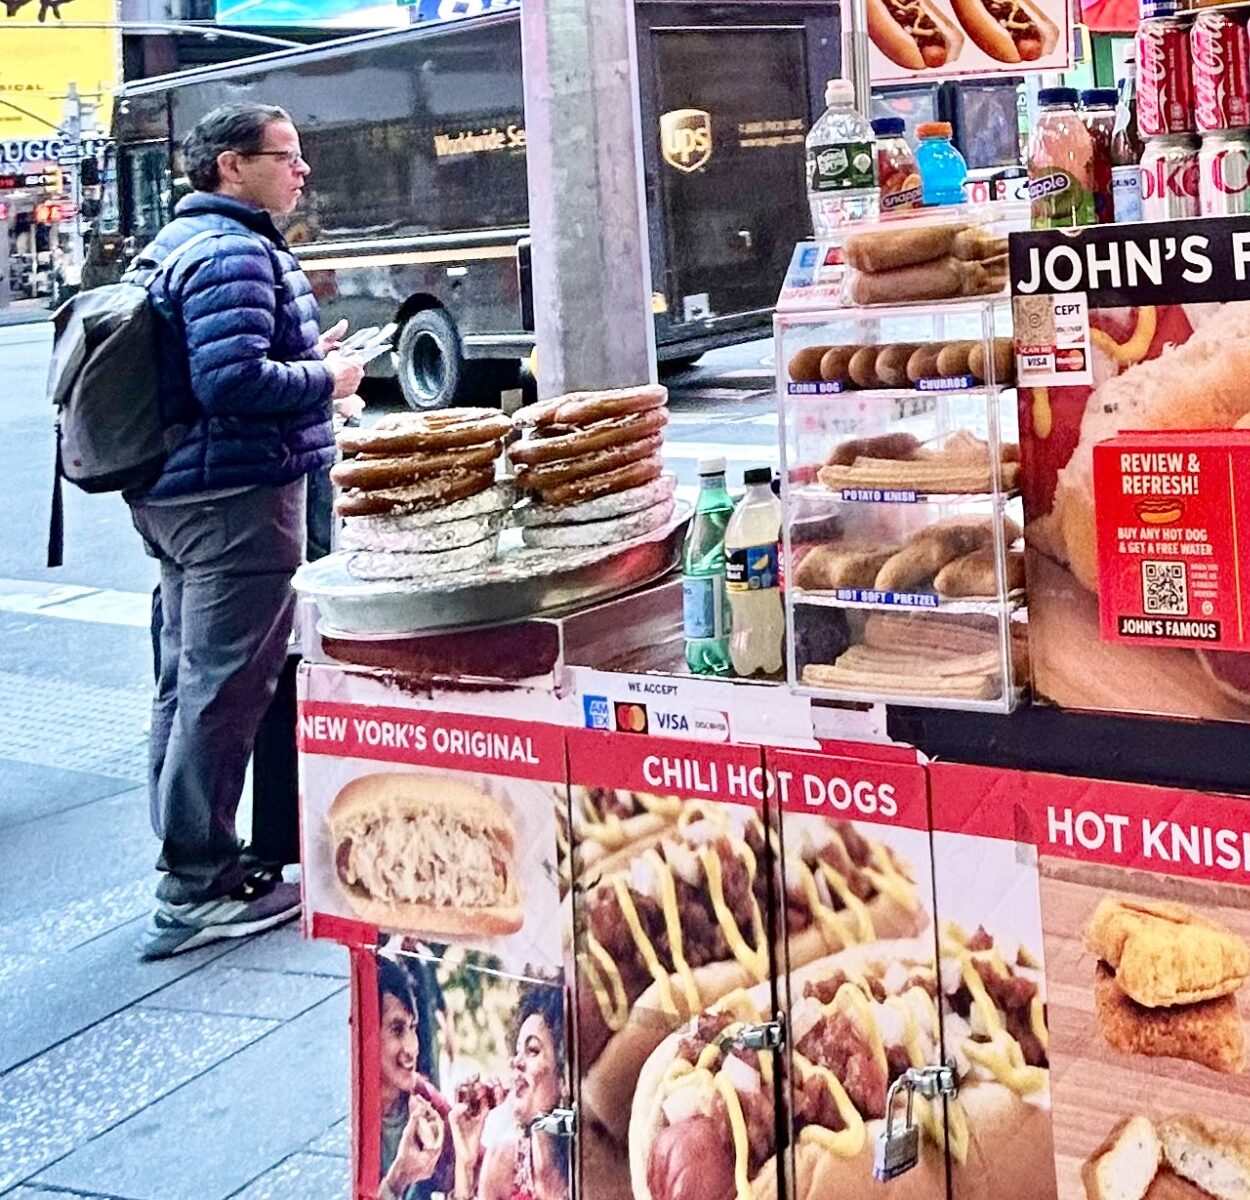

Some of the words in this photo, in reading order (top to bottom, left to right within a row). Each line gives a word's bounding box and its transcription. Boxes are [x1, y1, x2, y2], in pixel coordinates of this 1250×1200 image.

[671, 127, 708, 163] ups
[1016, 236, 1213, 295] JOHN'S
[1027, 357, 1048, 367] VISA
[1120, 453, 1184, 473] REVIEW
[1187, 453, 1201, 473] &
[1122, 475, 1200, 495] REFRESH!
[1117, 528, 1137, 541] BUY
[1140, 528, 1160, 541] ANY
[1162, 528, 1184, 542] HOT
[1185, 529, 1208, 542] DOG
[1155, 543, 1179, 555] FREE
[1180, 543, 1214, 557] WATER
[893, 592, 937, 608] PRETZEL
[1121, 619, 1163, 635] JOHN'S
[1165, 621, 1217, 638] FAMOUS
[627, 682, 643, 693] WE
[644, 683, 679, 696] ACCEPT
[655, 711, 690, 732] VISA
[299, 714, 348, 742] NEW
[352, 718, 428, 751] YORK'S
[432, 727, 540, 765] ORIGINAL
[642, 755, 718, 793] CHILI
[726, 764, 794, 803] HOT
[802, 774, 898, 818] DOGS
[1046, 805, 1130, 851] HOT
